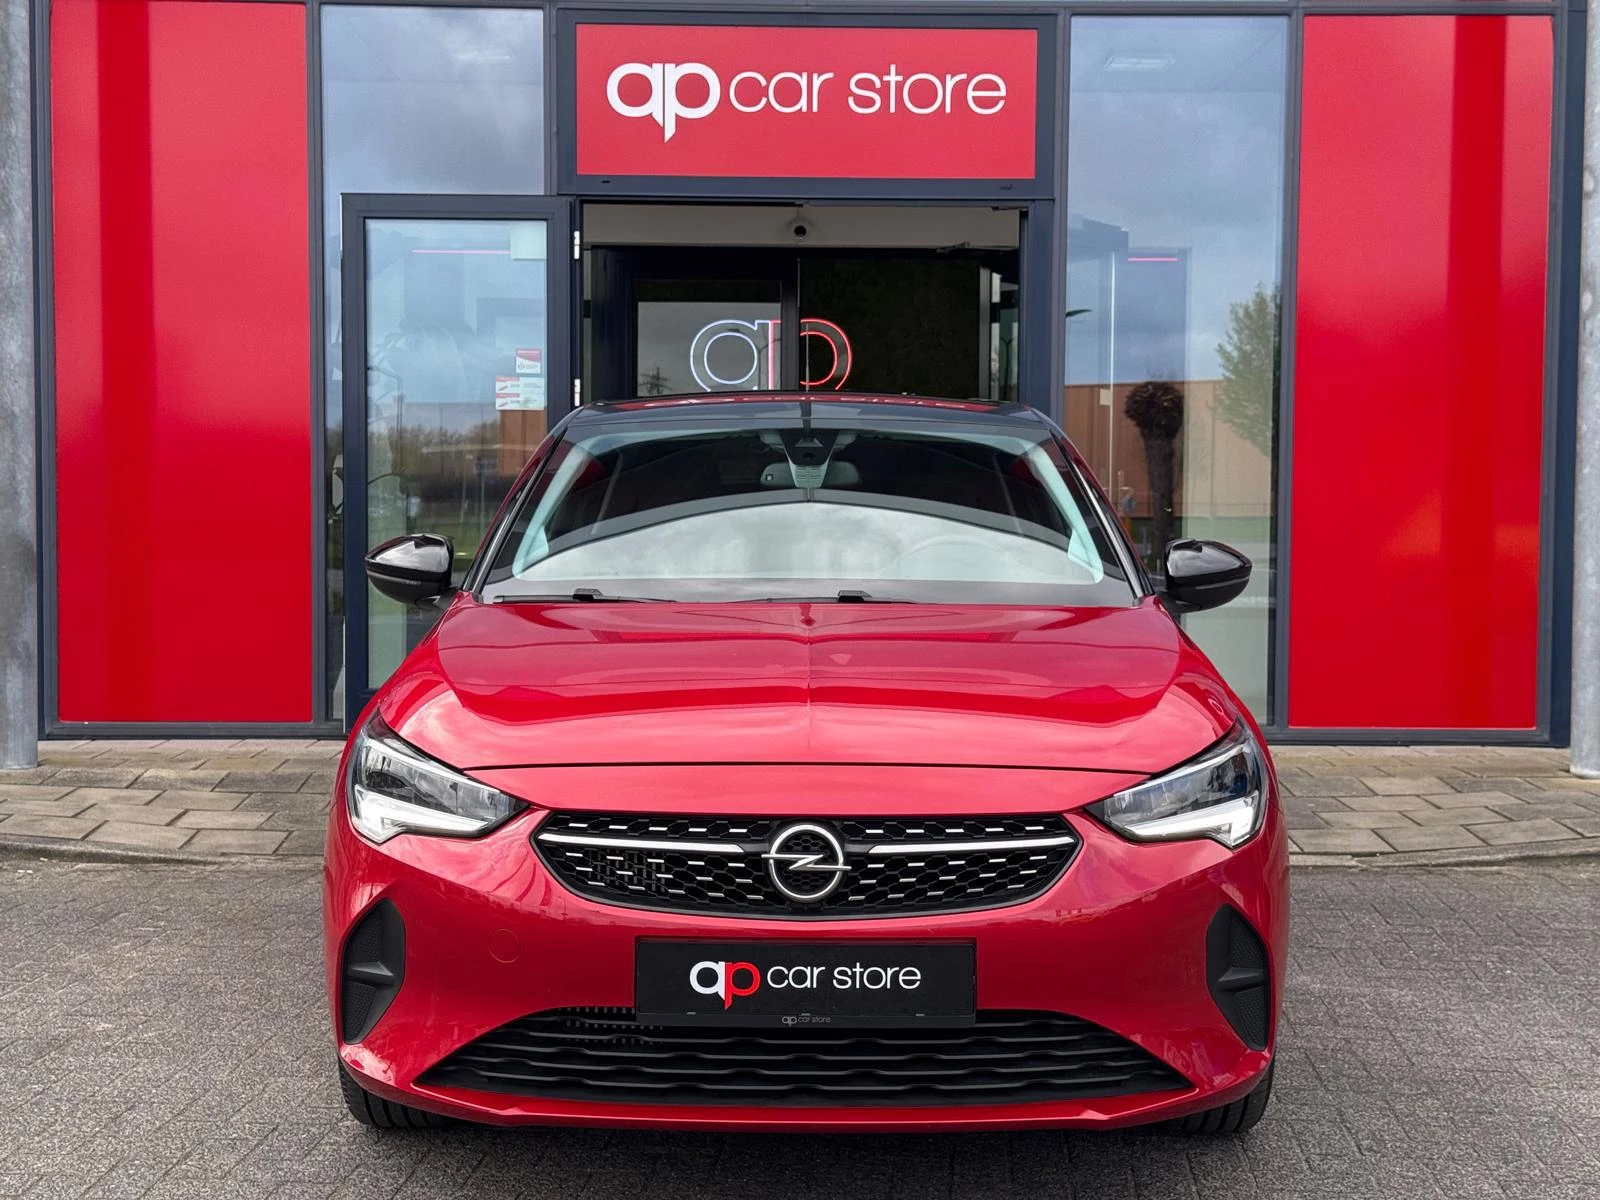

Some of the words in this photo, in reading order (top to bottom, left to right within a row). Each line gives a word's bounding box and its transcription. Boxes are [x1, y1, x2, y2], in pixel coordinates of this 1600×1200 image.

[606, 62, 721, 144] ap
[729, 71, 835, 113] car
[847, 63, 1007, 115] store
[689, 960, 761, 1010] ap
[766, 965, 826, 989] car
[832, 961, 922, 990] store
